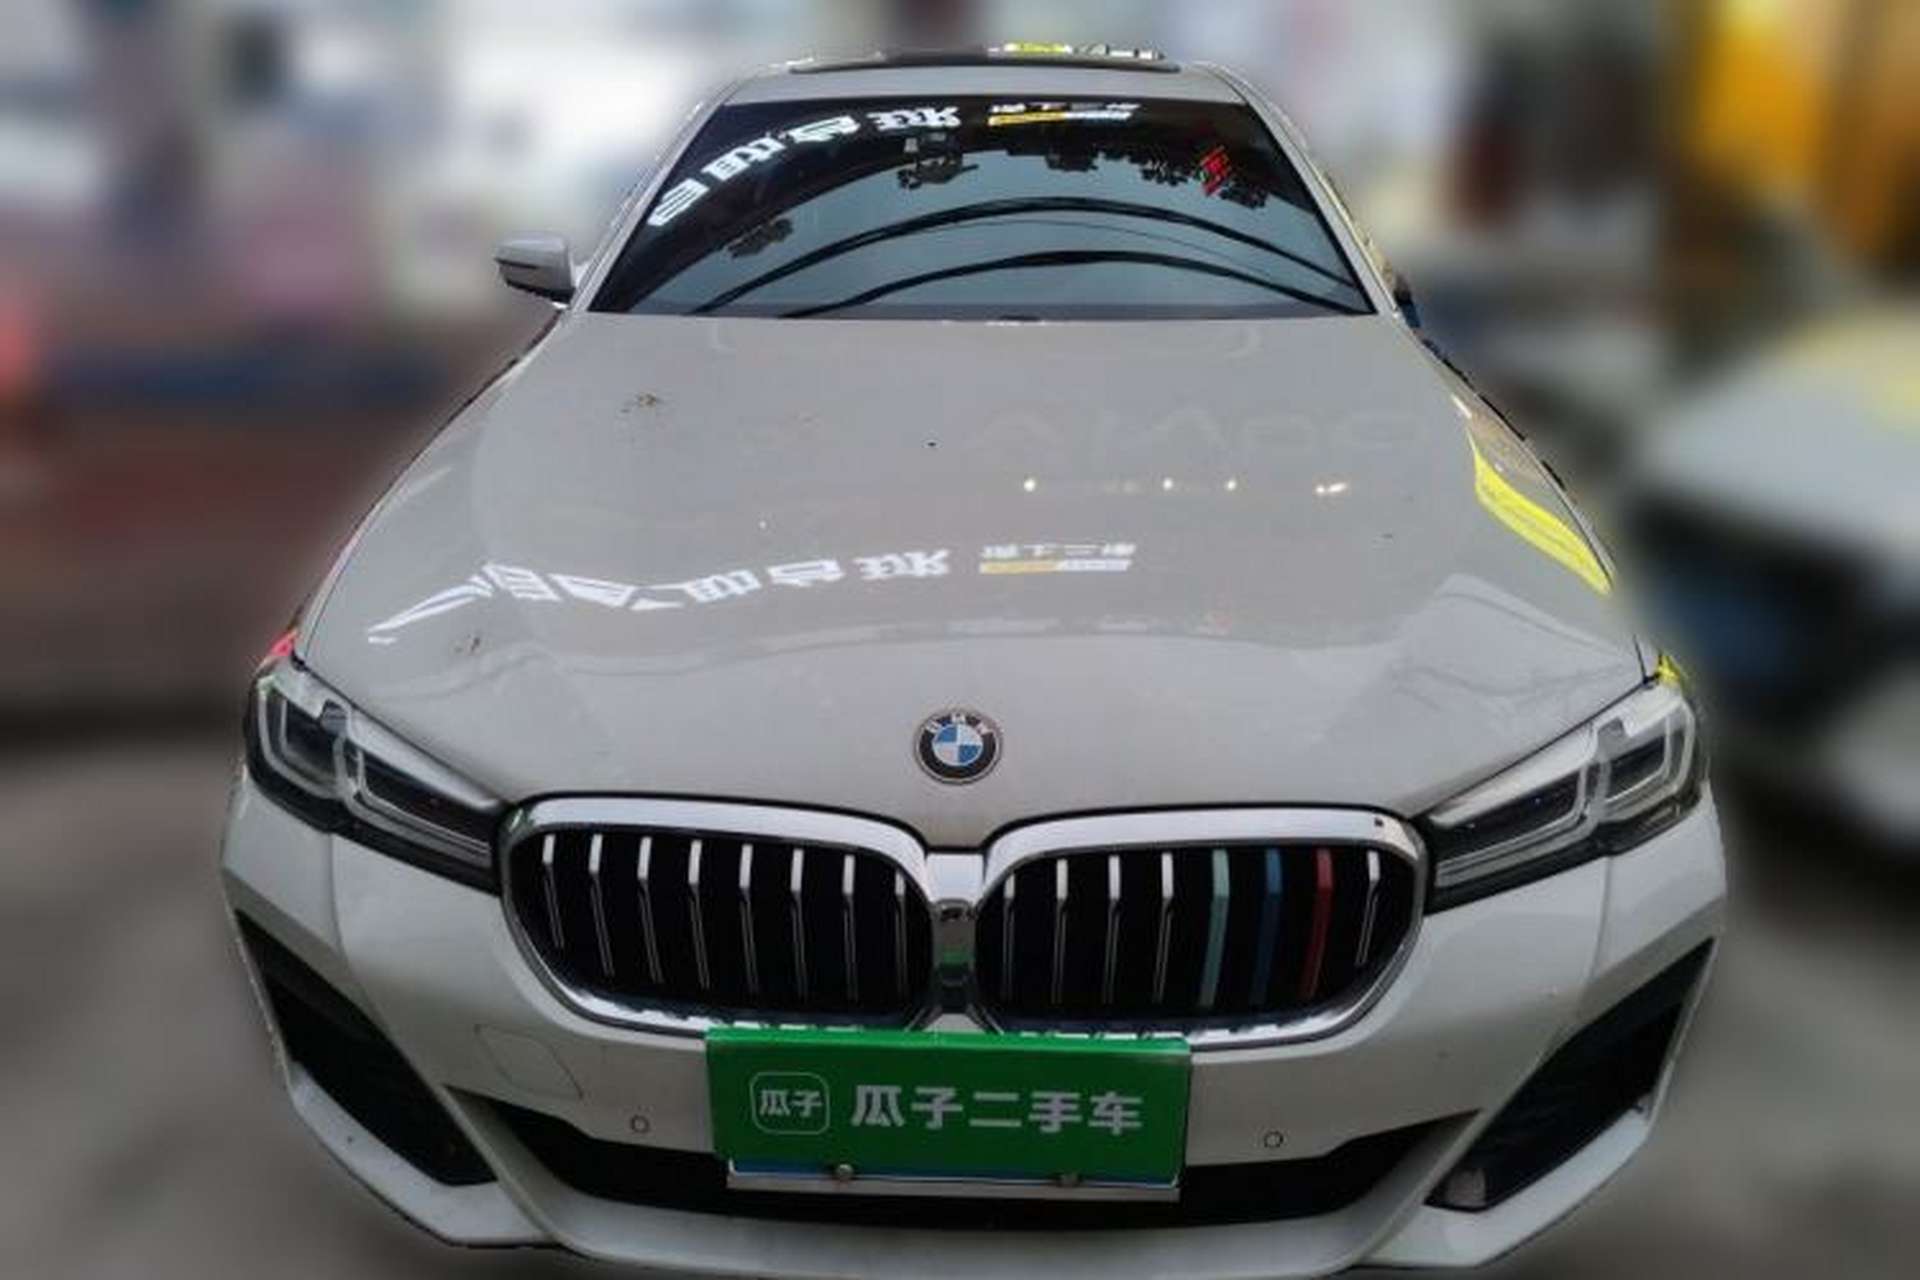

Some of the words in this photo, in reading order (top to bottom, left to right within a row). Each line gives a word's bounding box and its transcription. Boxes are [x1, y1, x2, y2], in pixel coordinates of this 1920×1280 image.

[760, 1089, 822, 1118] 瓜子
[852, 1085, 1142, 1135] 瓜子二手车
